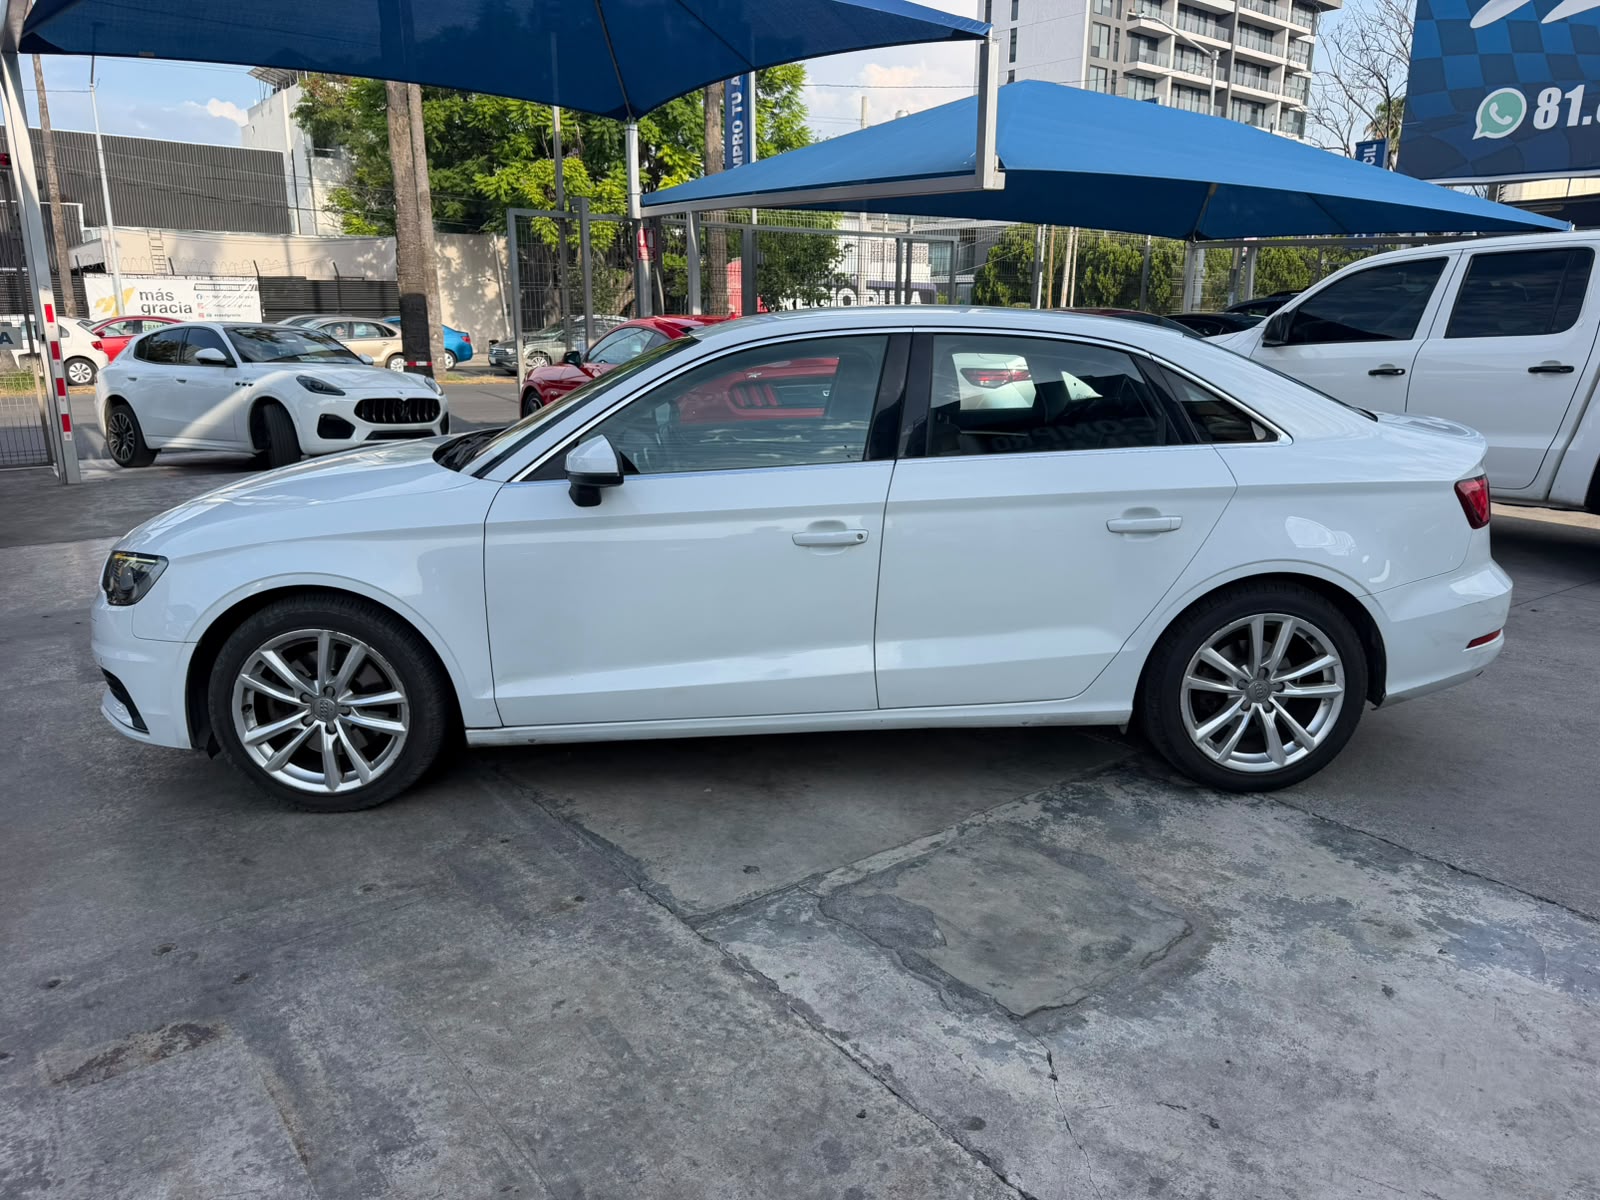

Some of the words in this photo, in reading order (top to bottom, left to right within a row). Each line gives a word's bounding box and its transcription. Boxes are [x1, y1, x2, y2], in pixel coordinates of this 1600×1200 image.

[731, 91, 743, 117] TU
[1533, 84, 1600, 130] 81.
[139, 287, 175, 301] más
[141, 301, 193, 315] gracia
